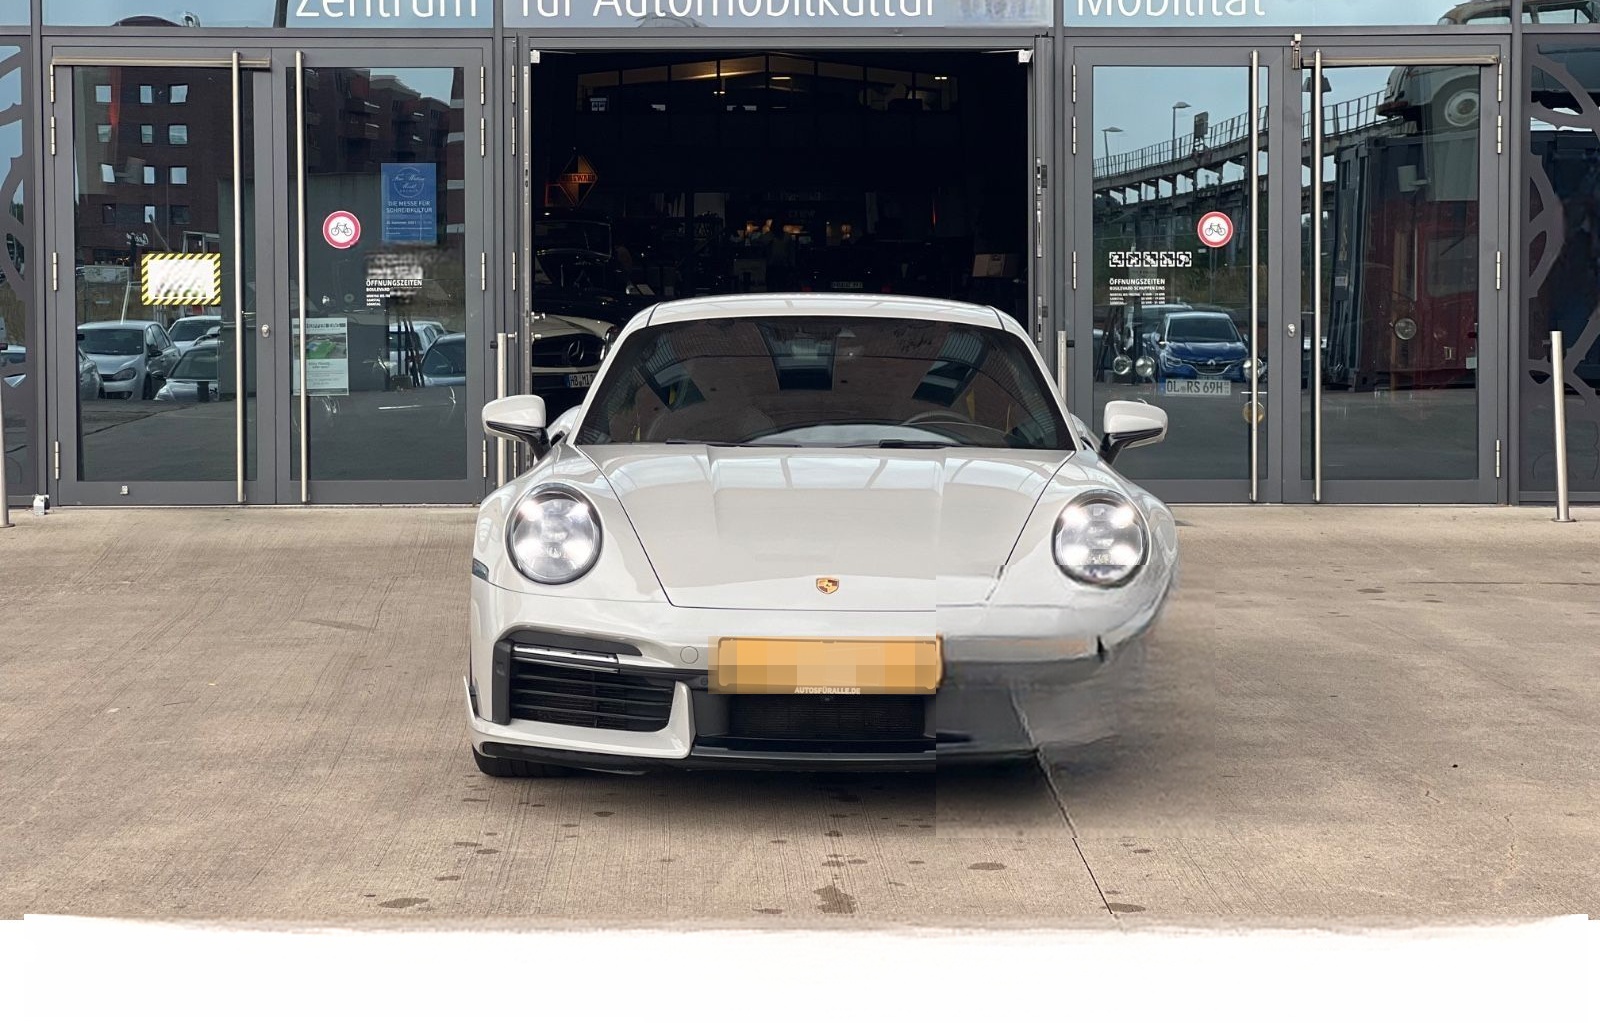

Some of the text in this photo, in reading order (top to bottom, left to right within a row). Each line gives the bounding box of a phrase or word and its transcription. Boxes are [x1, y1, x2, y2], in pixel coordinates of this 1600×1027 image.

[366, 278, 423, 287] ÖFFNUNGSZEITEN
[1166, 380, 1223, 393] OL RS 69H
[794, 686, 861, 695] AUTOSFÜRALLE.DE
